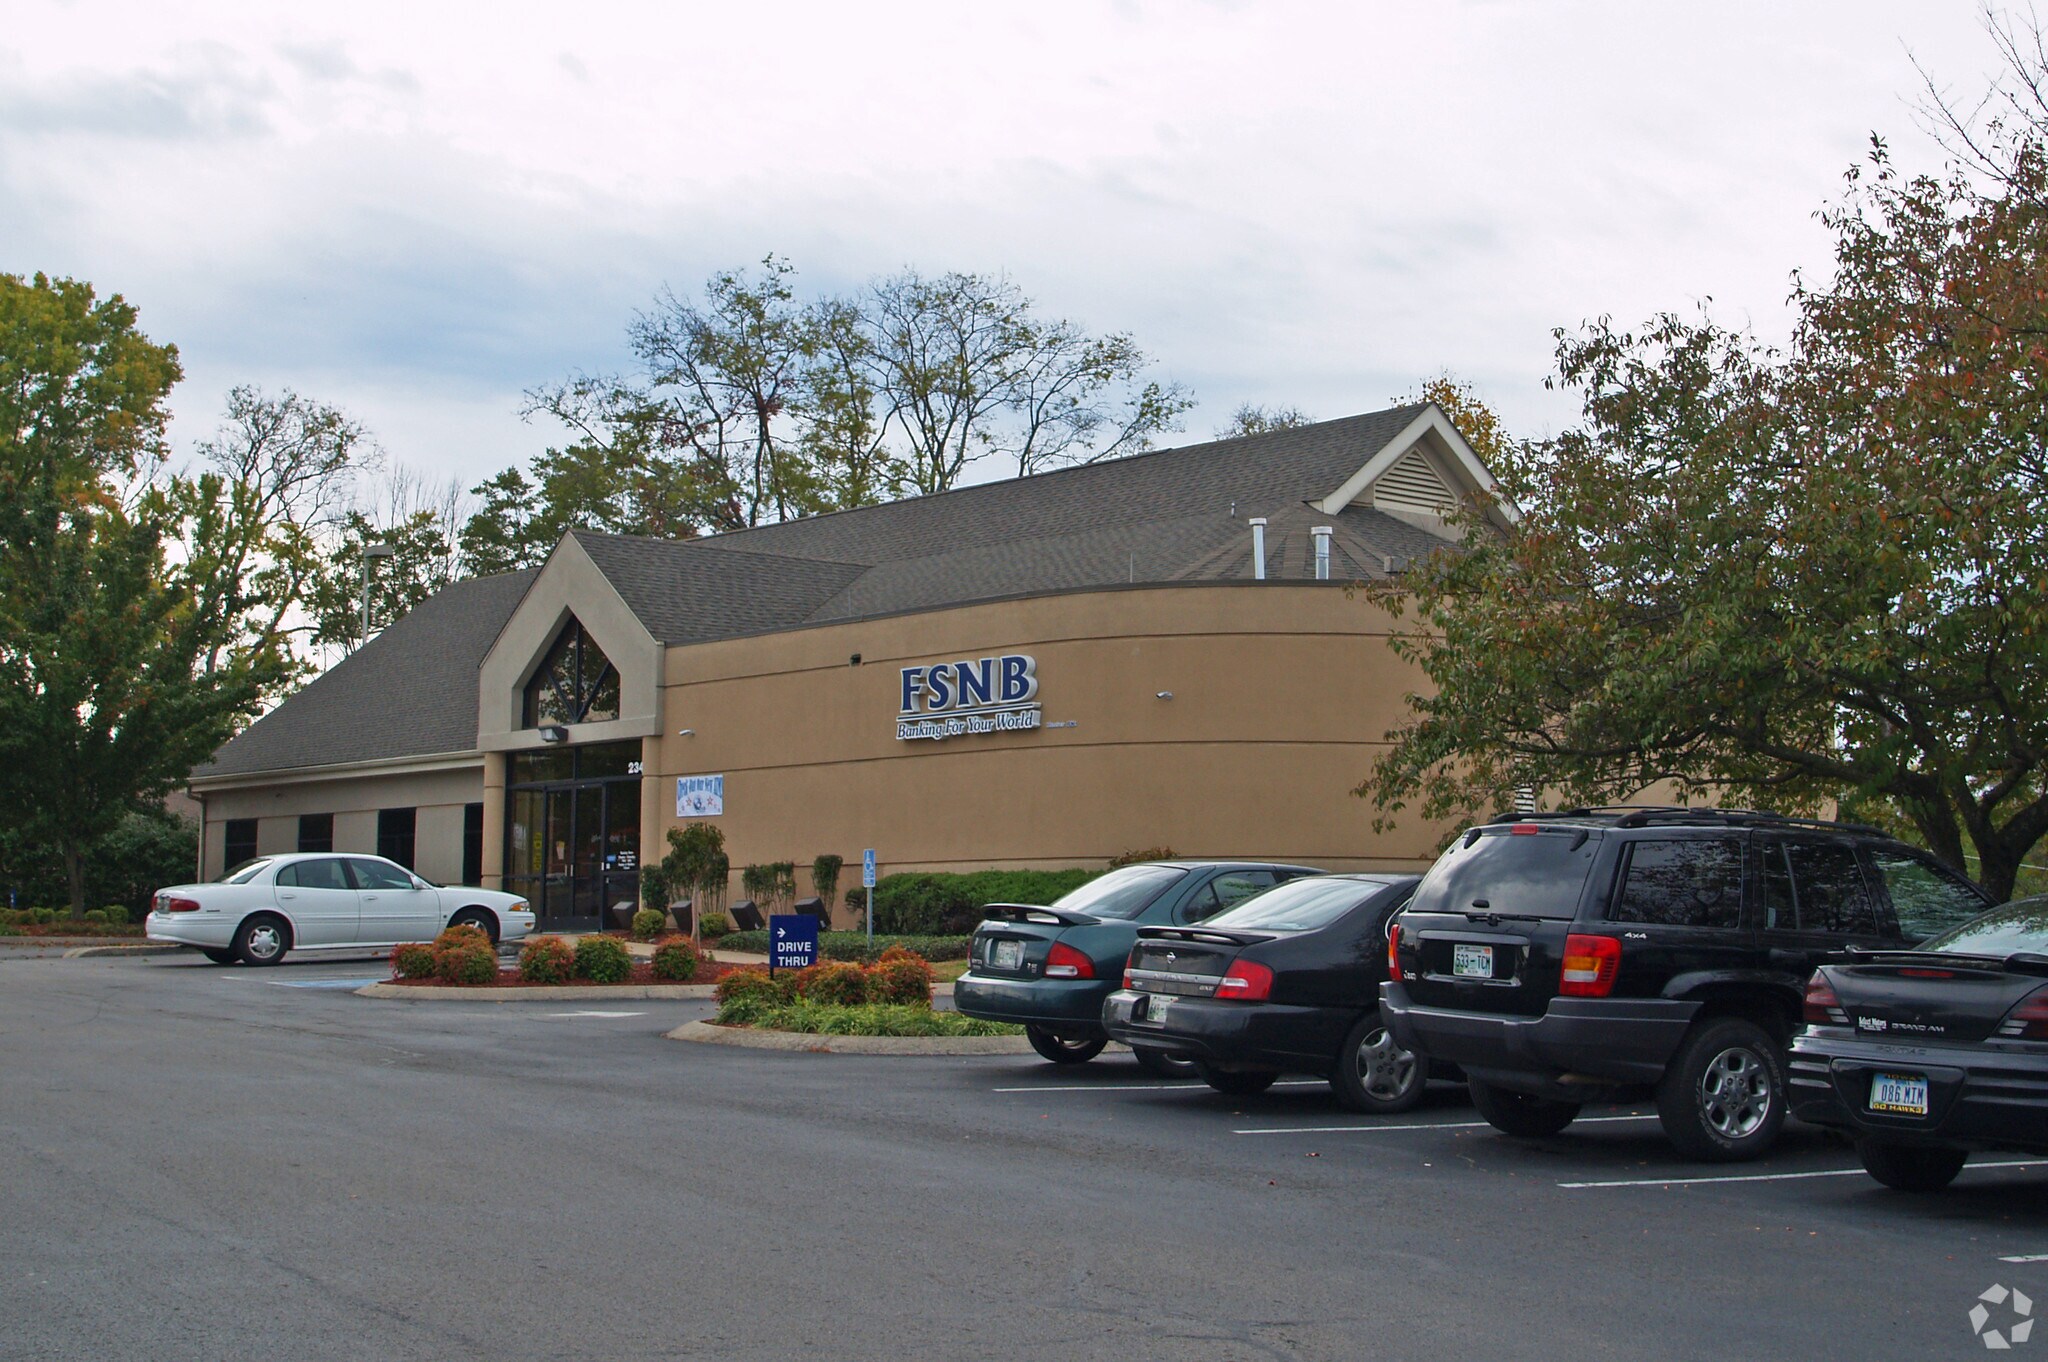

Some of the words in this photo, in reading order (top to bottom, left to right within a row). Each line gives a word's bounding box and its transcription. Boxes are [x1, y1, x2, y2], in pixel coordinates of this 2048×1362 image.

[900, 655, 1037, 713] FSNB
[897, 722, 942, 740] Banking
[944, 718, 964, 735] For
[967, 716, 993, 733] Your
[995, 710, 1034, 730] World
[777, 942, 812, 952] DRIVE
[777, 956, 809, 967] THRU
[1891, 1022, 1926, 1031] GRAND
